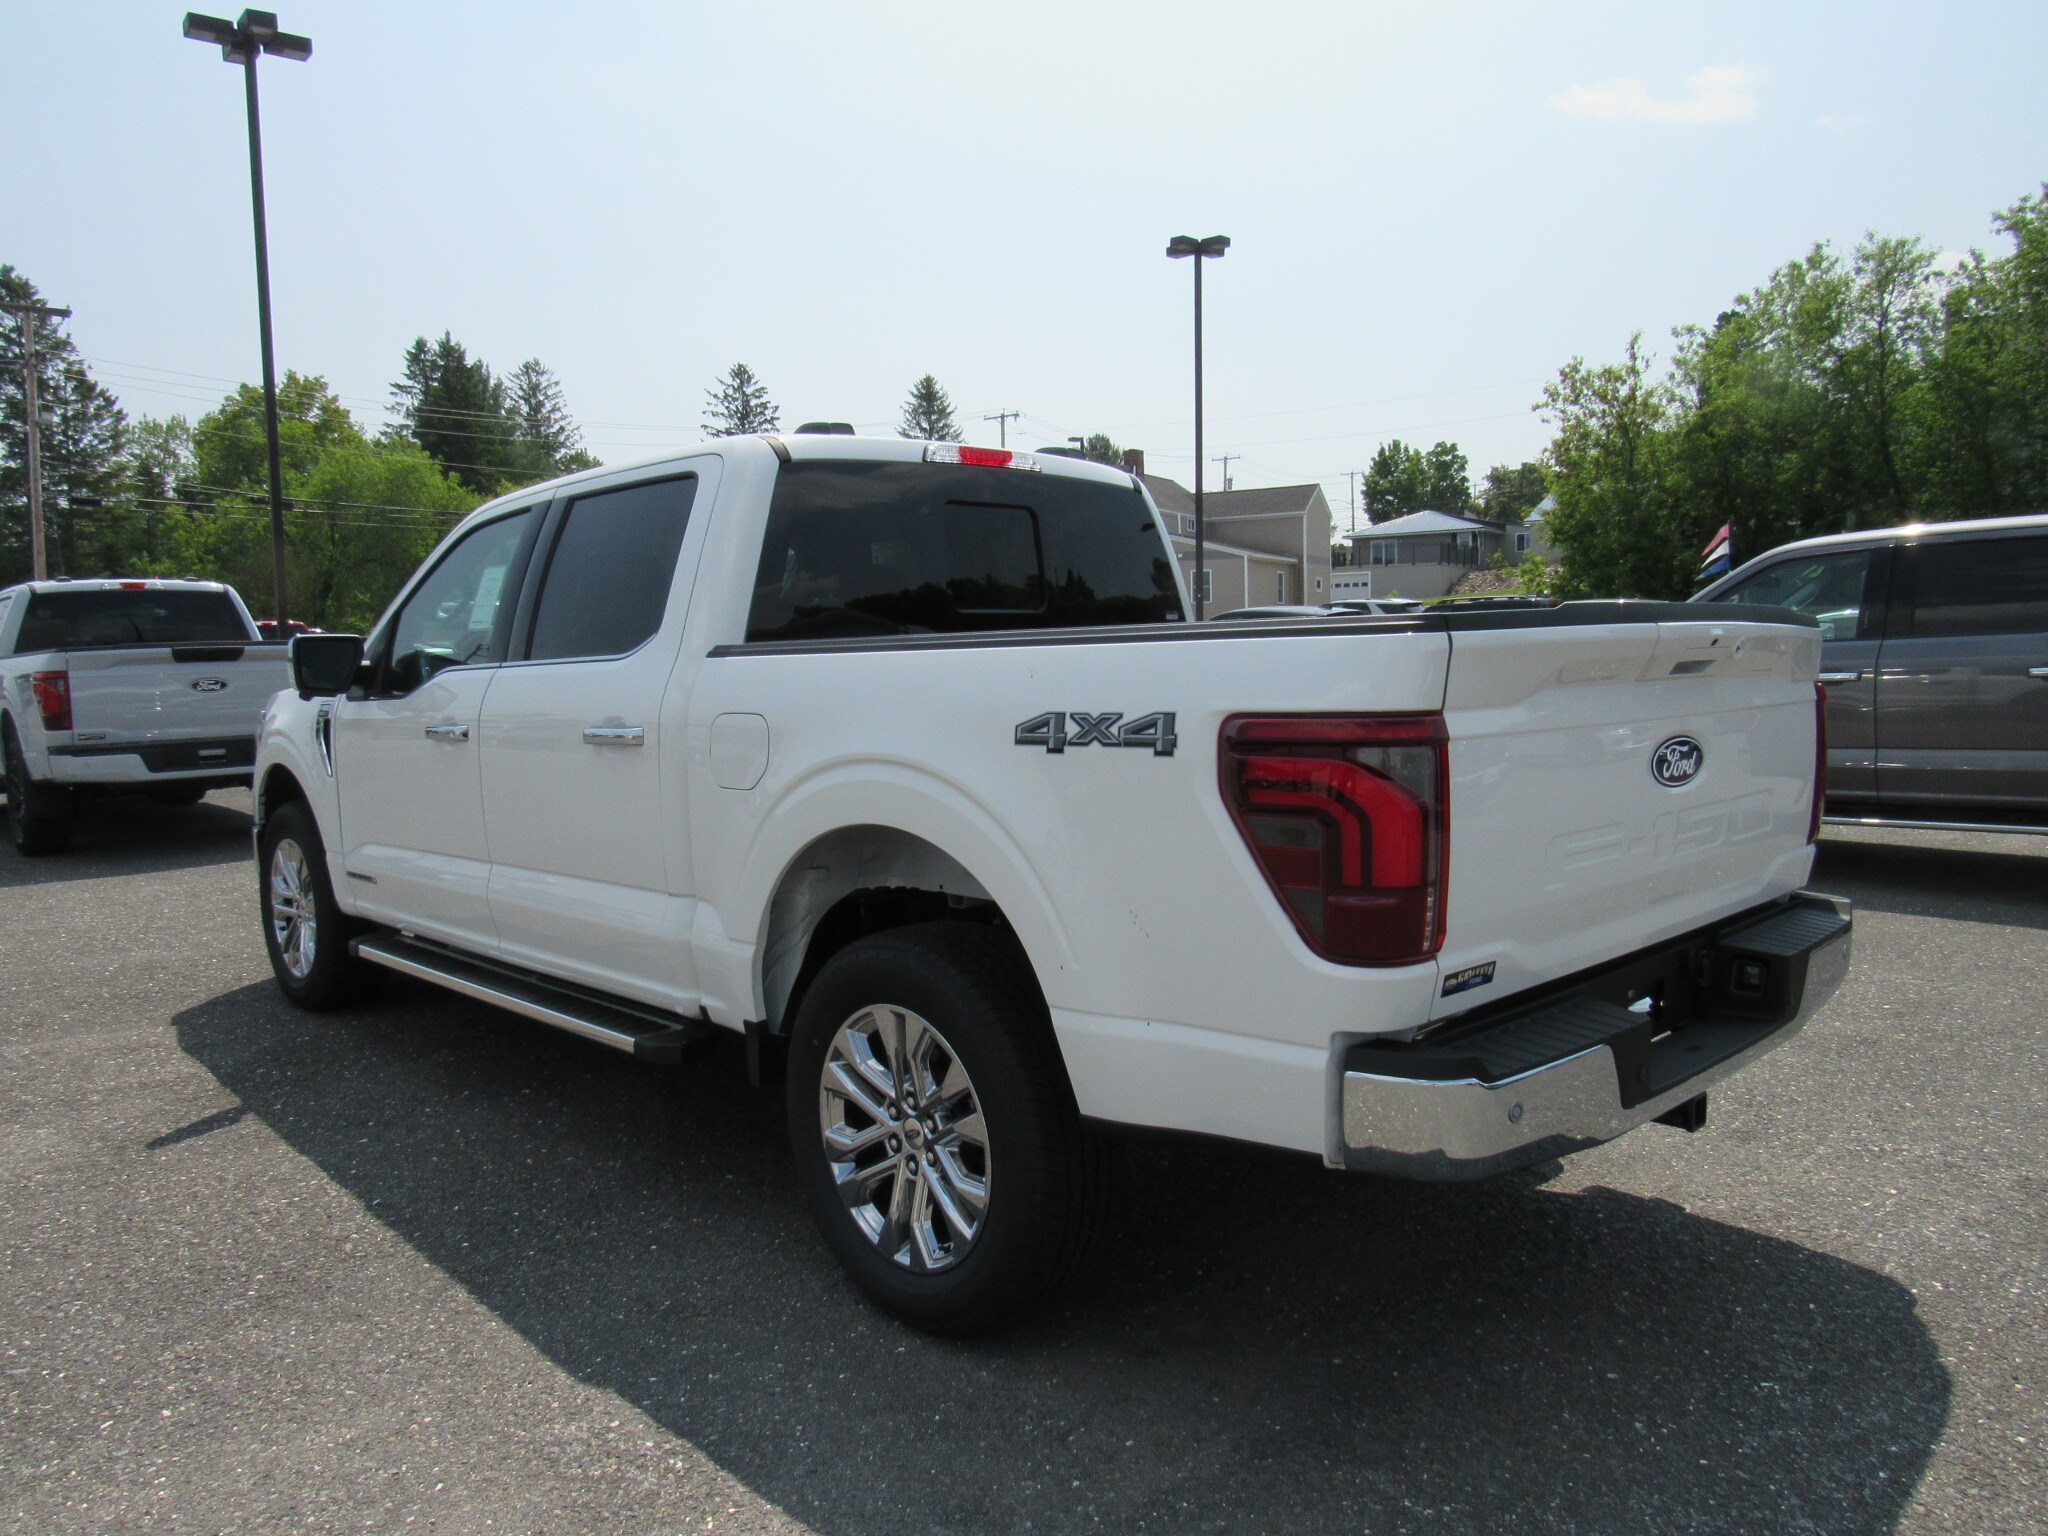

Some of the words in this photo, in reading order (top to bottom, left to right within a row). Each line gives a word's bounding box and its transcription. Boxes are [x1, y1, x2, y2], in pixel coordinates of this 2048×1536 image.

[195, 680, 222, 691] Ford
[1658, 742, 1698, 781] Ford
[1543, 787, 1775, 891] F-150
